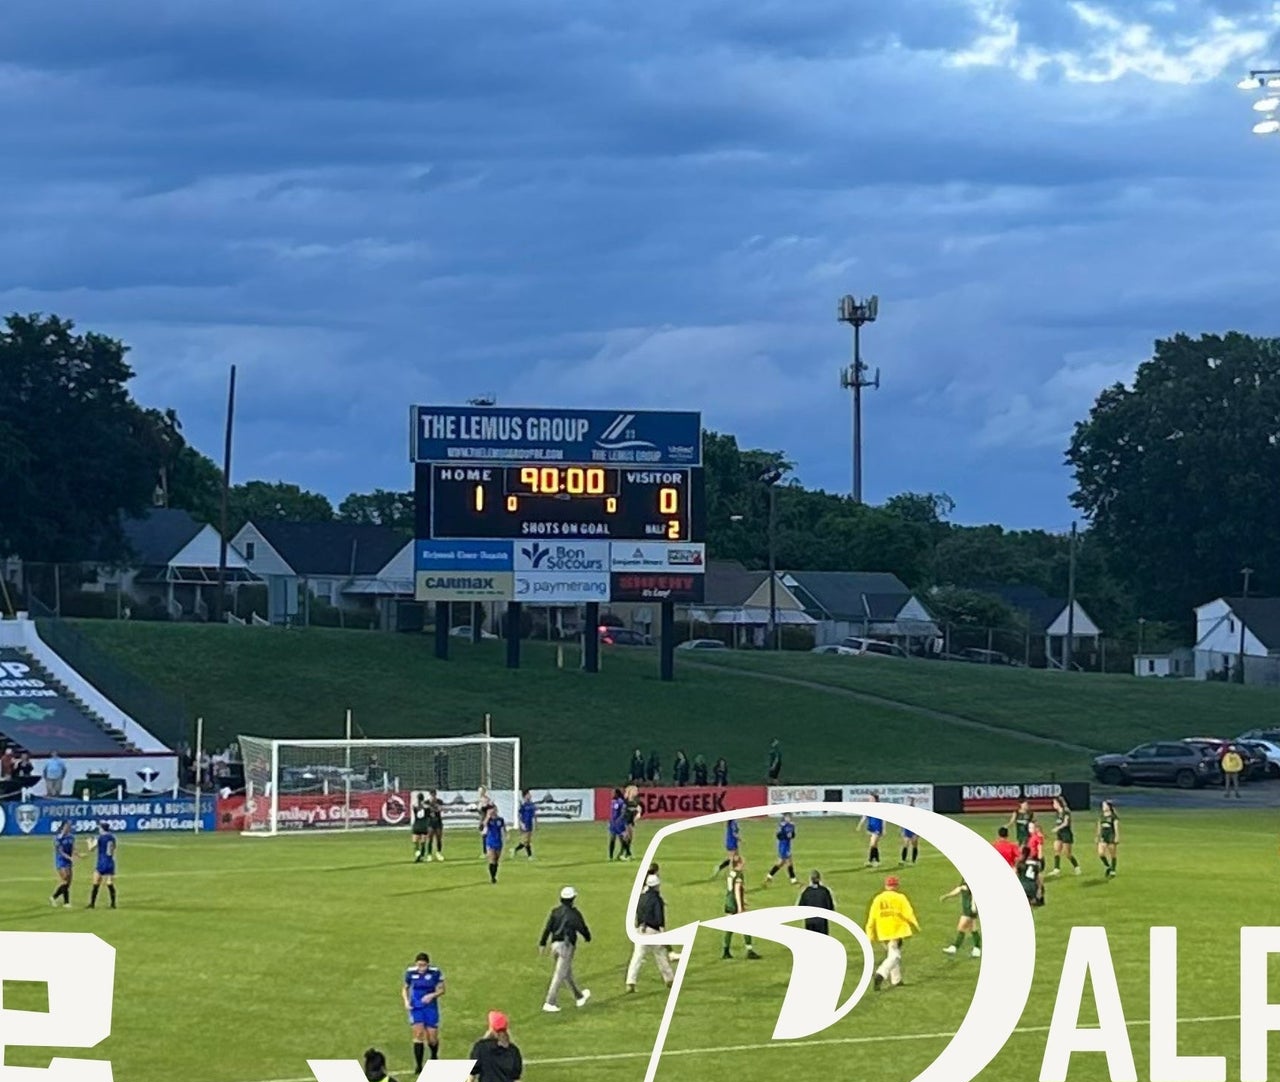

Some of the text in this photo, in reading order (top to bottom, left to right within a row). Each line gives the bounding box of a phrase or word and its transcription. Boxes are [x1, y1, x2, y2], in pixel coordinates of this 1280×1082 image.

[421, 414, 589, 442] THE LEMUS GROUP
[440, 469, 492, 481] HOME
[520, 467, 605, 494] 90:00
[626, 472, 682, 485] VISITOR
[475, 485, 484, 512] 1
[507, 496, 518, 512] 0
[606, 498, 617, 513] 0
[659, 488, 678, 514] 0
[521, 521, 610, 535] SHOTS ON GOAL
[668, 520, 679, 539] 2
[556, 546, 585, 559] Bon
[547, 556, 603, 570] Secours
[532, 579, 607, 595] paymerang
[962, 784, 1063, 799] RICHMOND UNITED
[43, 803, 89, 815] PROTECT
[91, 803, 120, 815] YOUR
[120, 803, 152, 815] HOME
[153, 802, 163, 814] &
[640, 790, 726, 816] SEATGEEK
[329, 806, 369, 819] Gass
